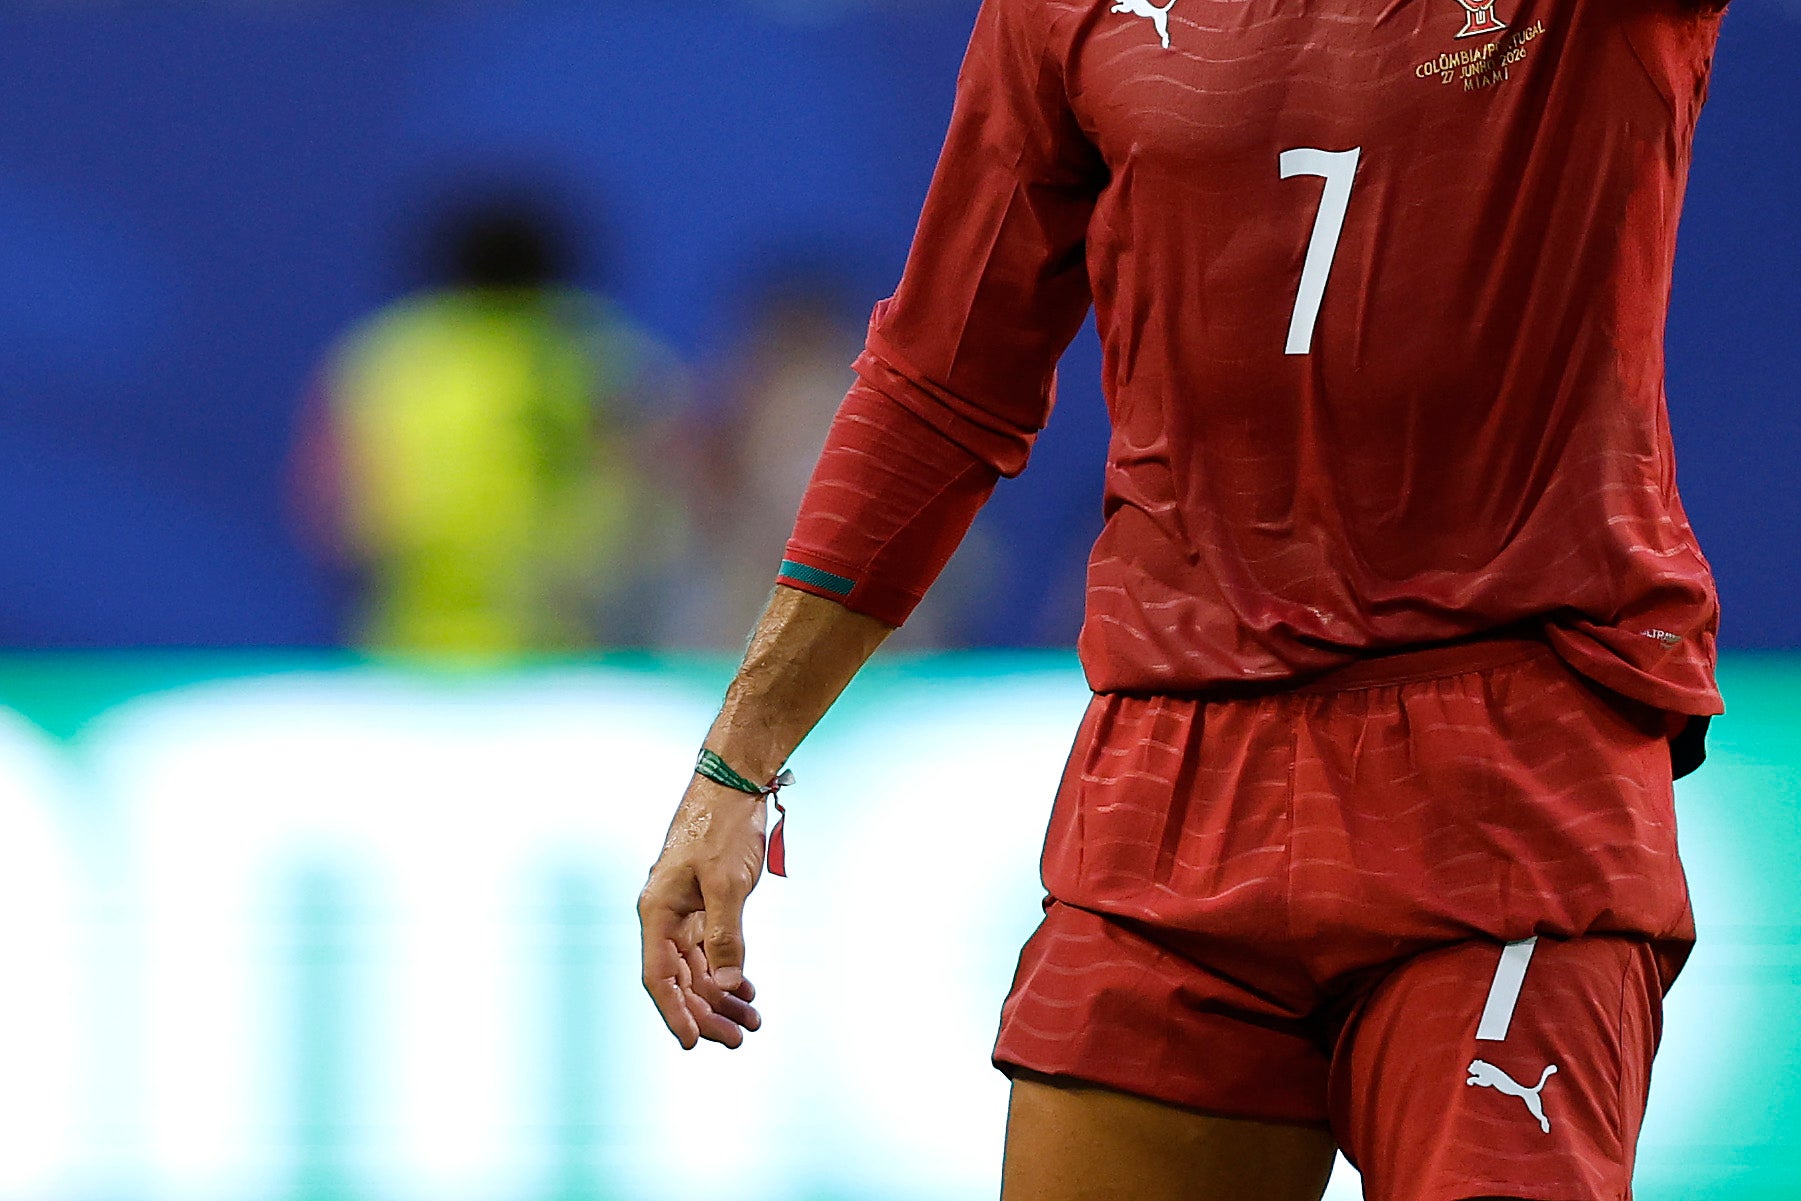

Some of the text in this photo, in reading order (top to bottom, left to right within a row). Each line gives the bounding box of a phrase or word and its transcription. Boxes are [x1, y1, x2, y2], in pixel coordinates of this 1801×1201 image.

[1441, 69, 1455, 84] 27
[1500, 47, 1527, 67] 2026
[1463, 66, 1509, 92] MIAMI
[1279, 146, 1361, 355] 7
